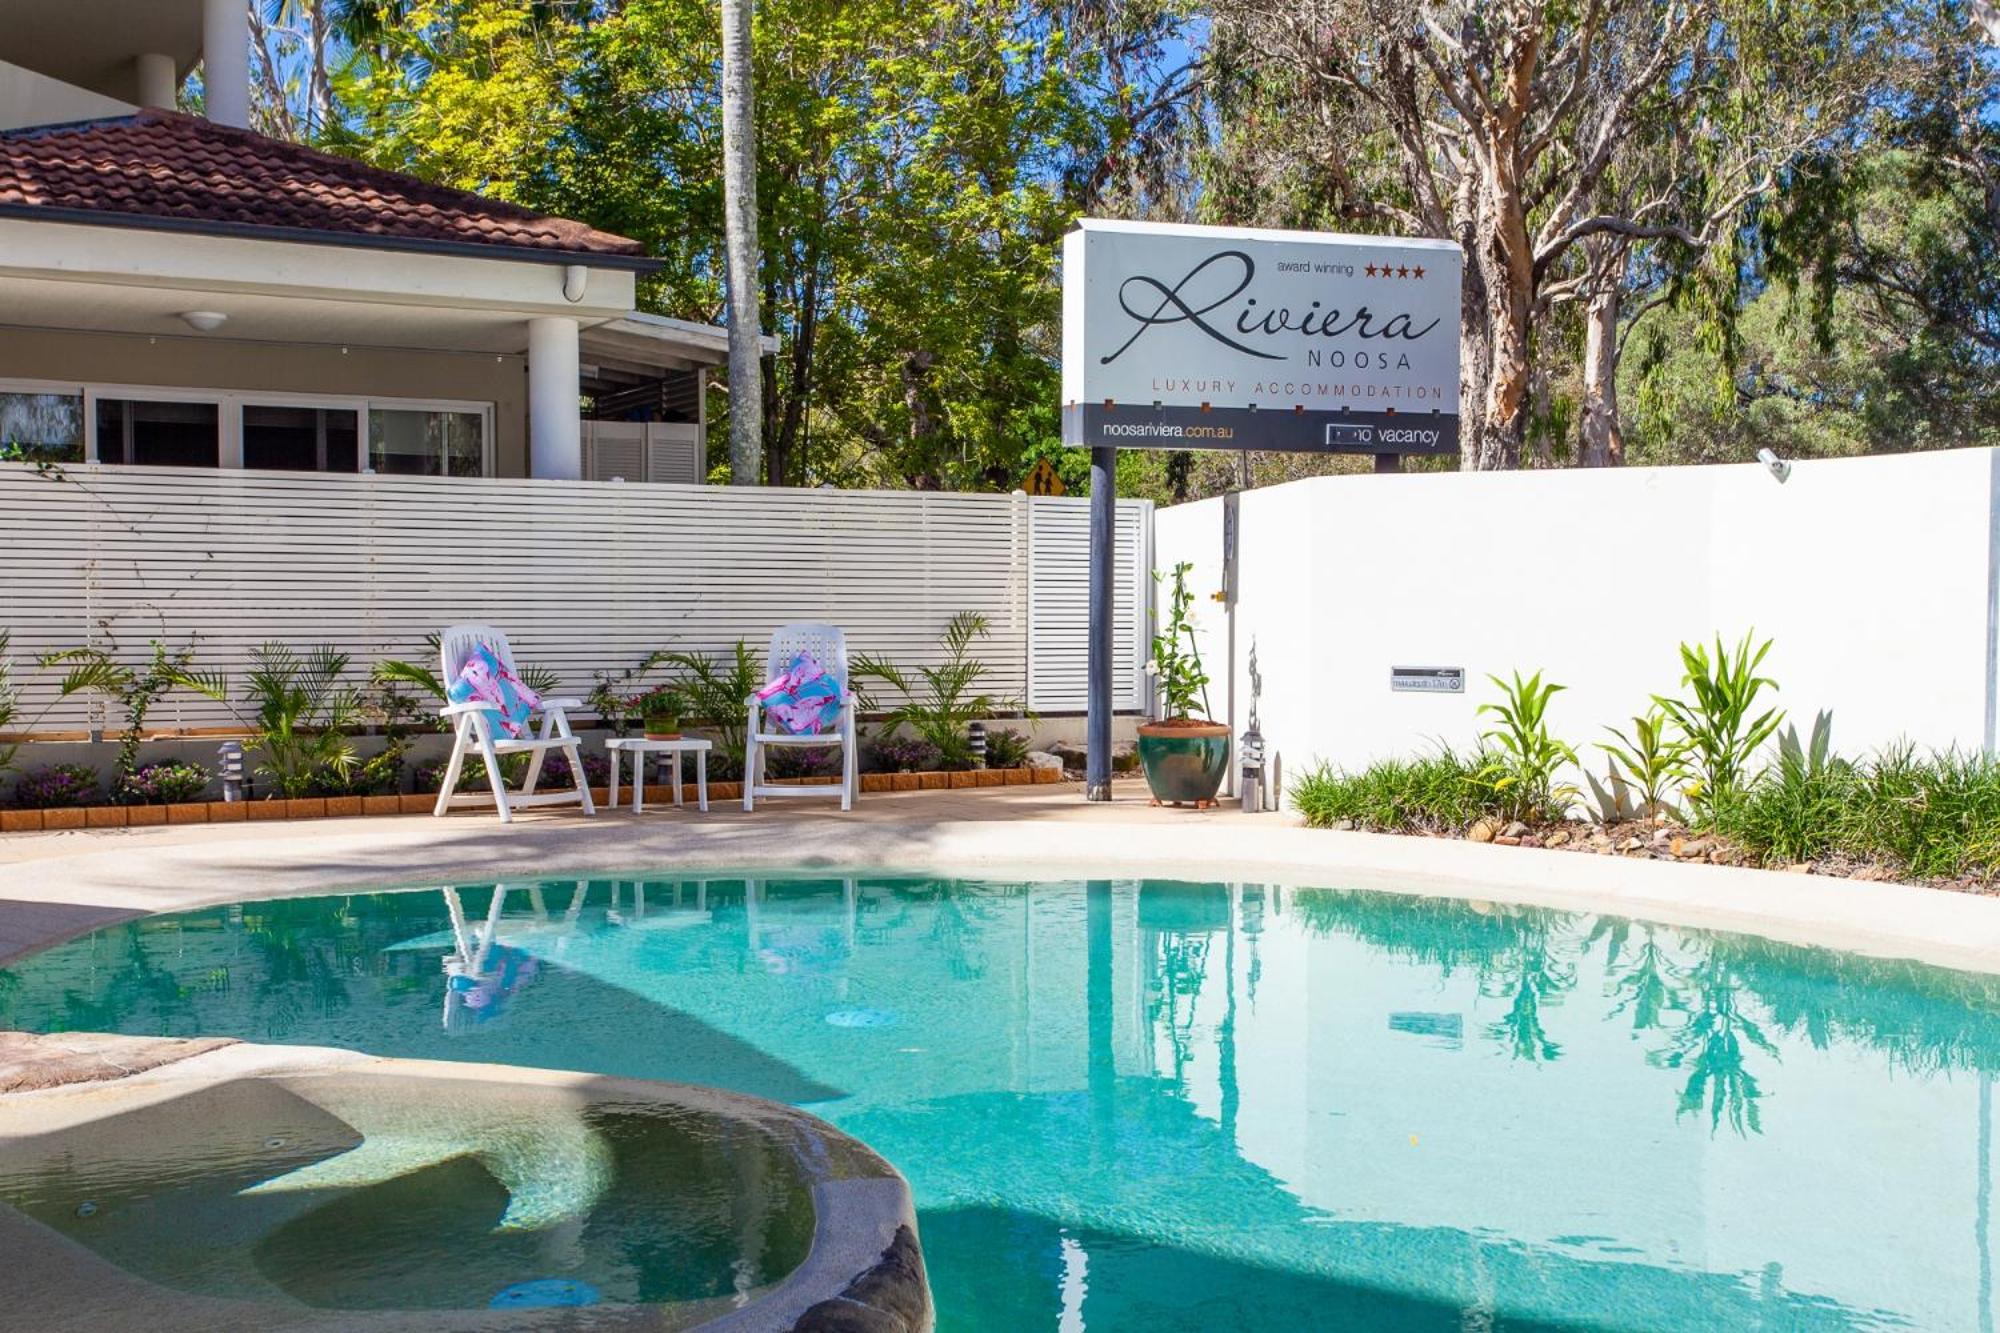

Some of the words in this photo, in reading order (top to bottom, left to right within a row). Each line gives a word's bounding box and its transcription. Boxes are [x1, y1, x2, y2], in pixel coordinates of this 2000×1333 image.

[1277, 261, 1310, 273] award
[1314, 262, 1354, 277] winning
[1101, 251, 1440, 365] Riviera
[1308, 350, 1411, 370] NOOSA
[1152, 378, 1236, 393] LUXURY
[1254, 382, 1442, 399] ACCOMMODATION
[1103, 422, 1234, 438] noosariviera.com.au
[1378, 428, 1440, 447] vacancy
